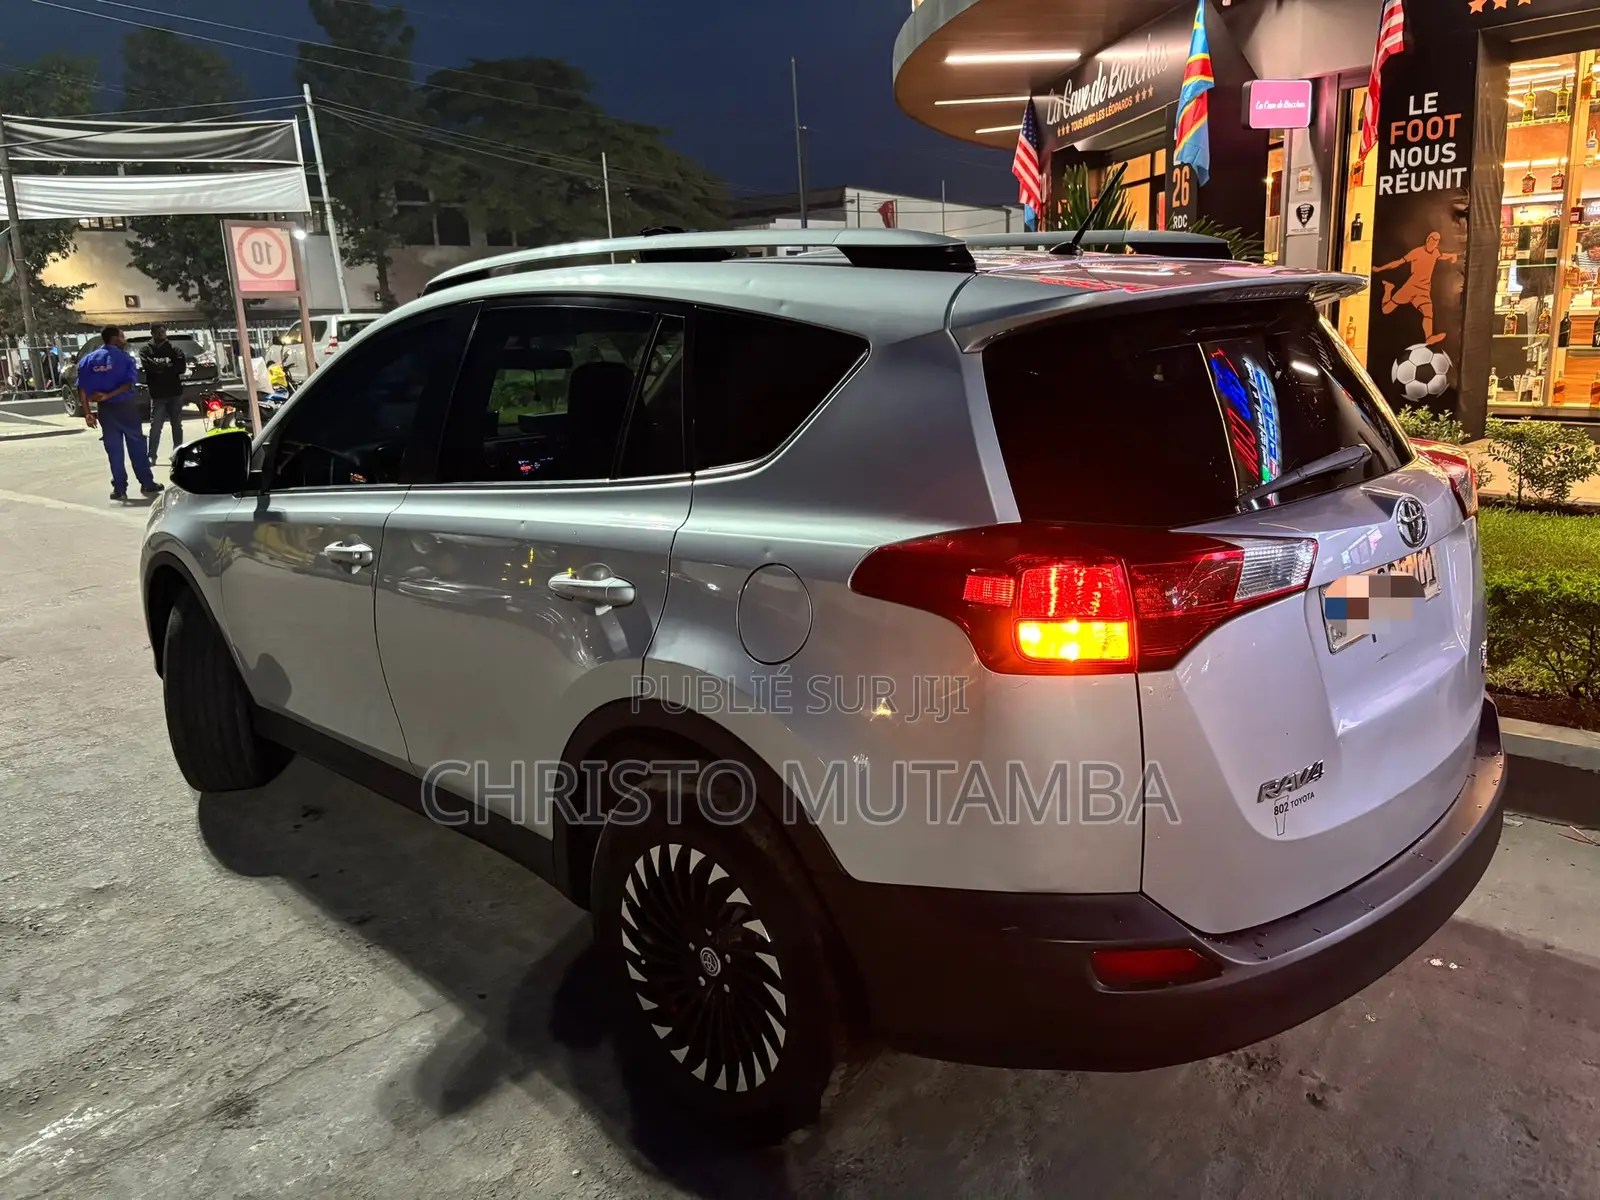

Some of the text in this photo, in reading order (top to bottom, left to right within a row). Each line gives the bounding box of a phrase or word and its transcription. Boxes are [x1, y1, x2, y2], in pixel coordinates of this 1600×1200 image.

[1062, 79, 1091, 119] Cave
[1091, 62, 1108, 107] de
[1107, 33, 1168, 99] Bacchus
[1071, 94, 1133, 132] TOUS AVEC LES LÉOPARDS
[1408, 91, 1439, 116] LE
[1390, 113, 1462, 145] FOOT
[1389, 142, 1457, 169] NOUS
[1172, 165, 1190, 208] 26
[1379, 167, 1467, 196] RÉUNIT
[1172, 214, 1188, 229] RDC
[1257, 759, 1324, 803] RAV4
[1273, 791, 1315, 816] 802 TOYOTA
